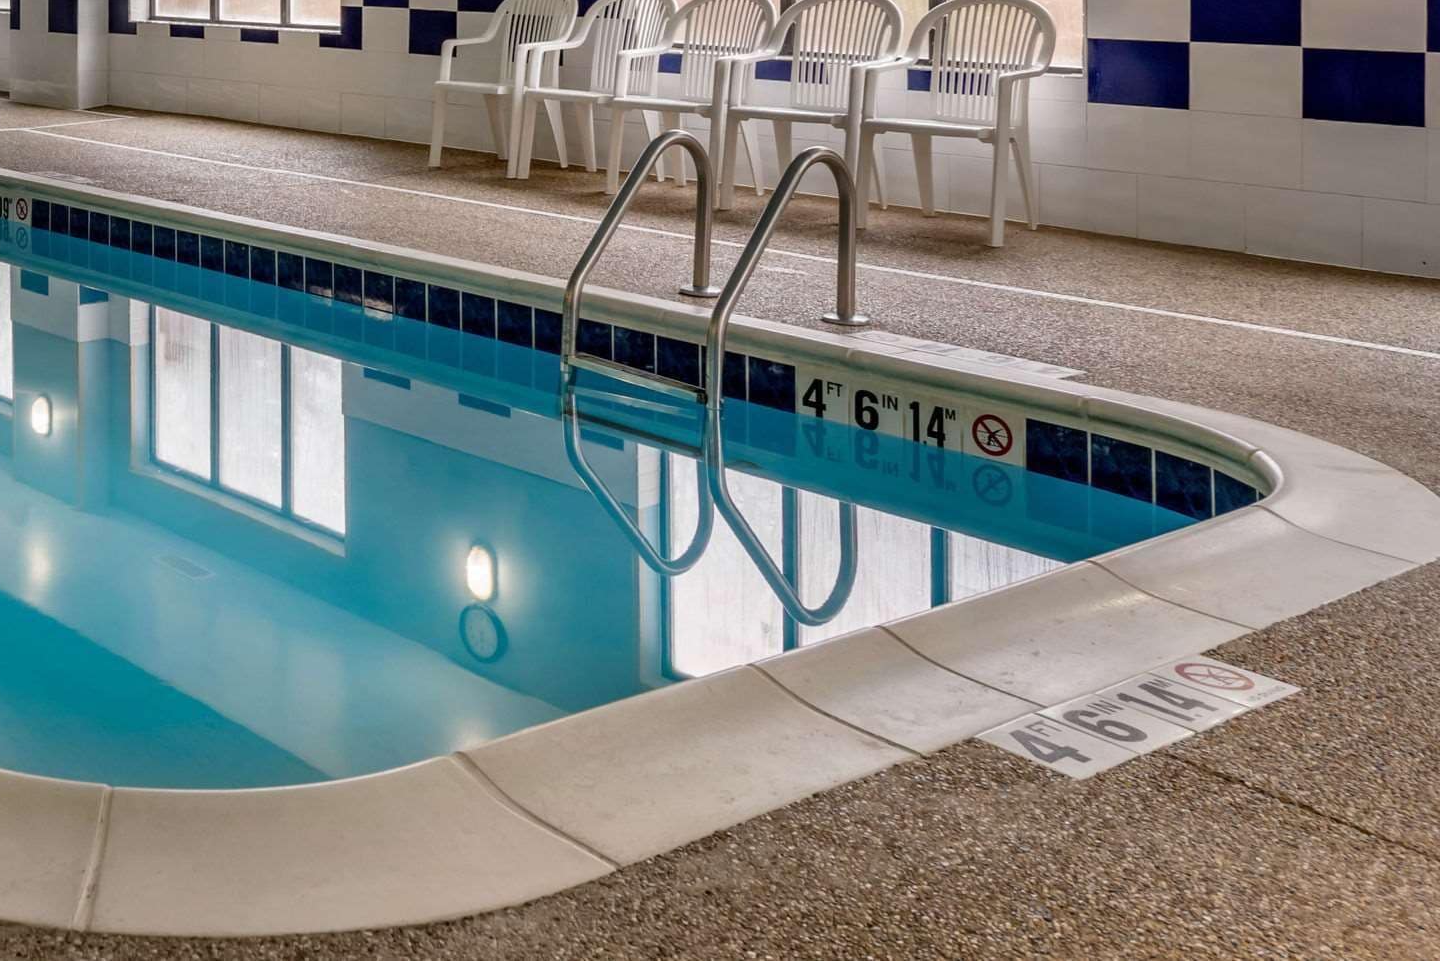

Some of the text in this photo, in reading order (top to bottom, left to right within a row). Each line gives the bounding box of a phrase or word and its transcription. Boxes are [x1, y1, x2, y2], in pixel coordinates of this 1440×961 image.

[802, 378, 827, 418] 4
[826, 381, 843, 397] FT
[854, 389, 879, 431] 6
[882, 394, 899, 411] IN
[1008, 729, 1092, 764] 4
[1062, 710, 1148, 743] 6
